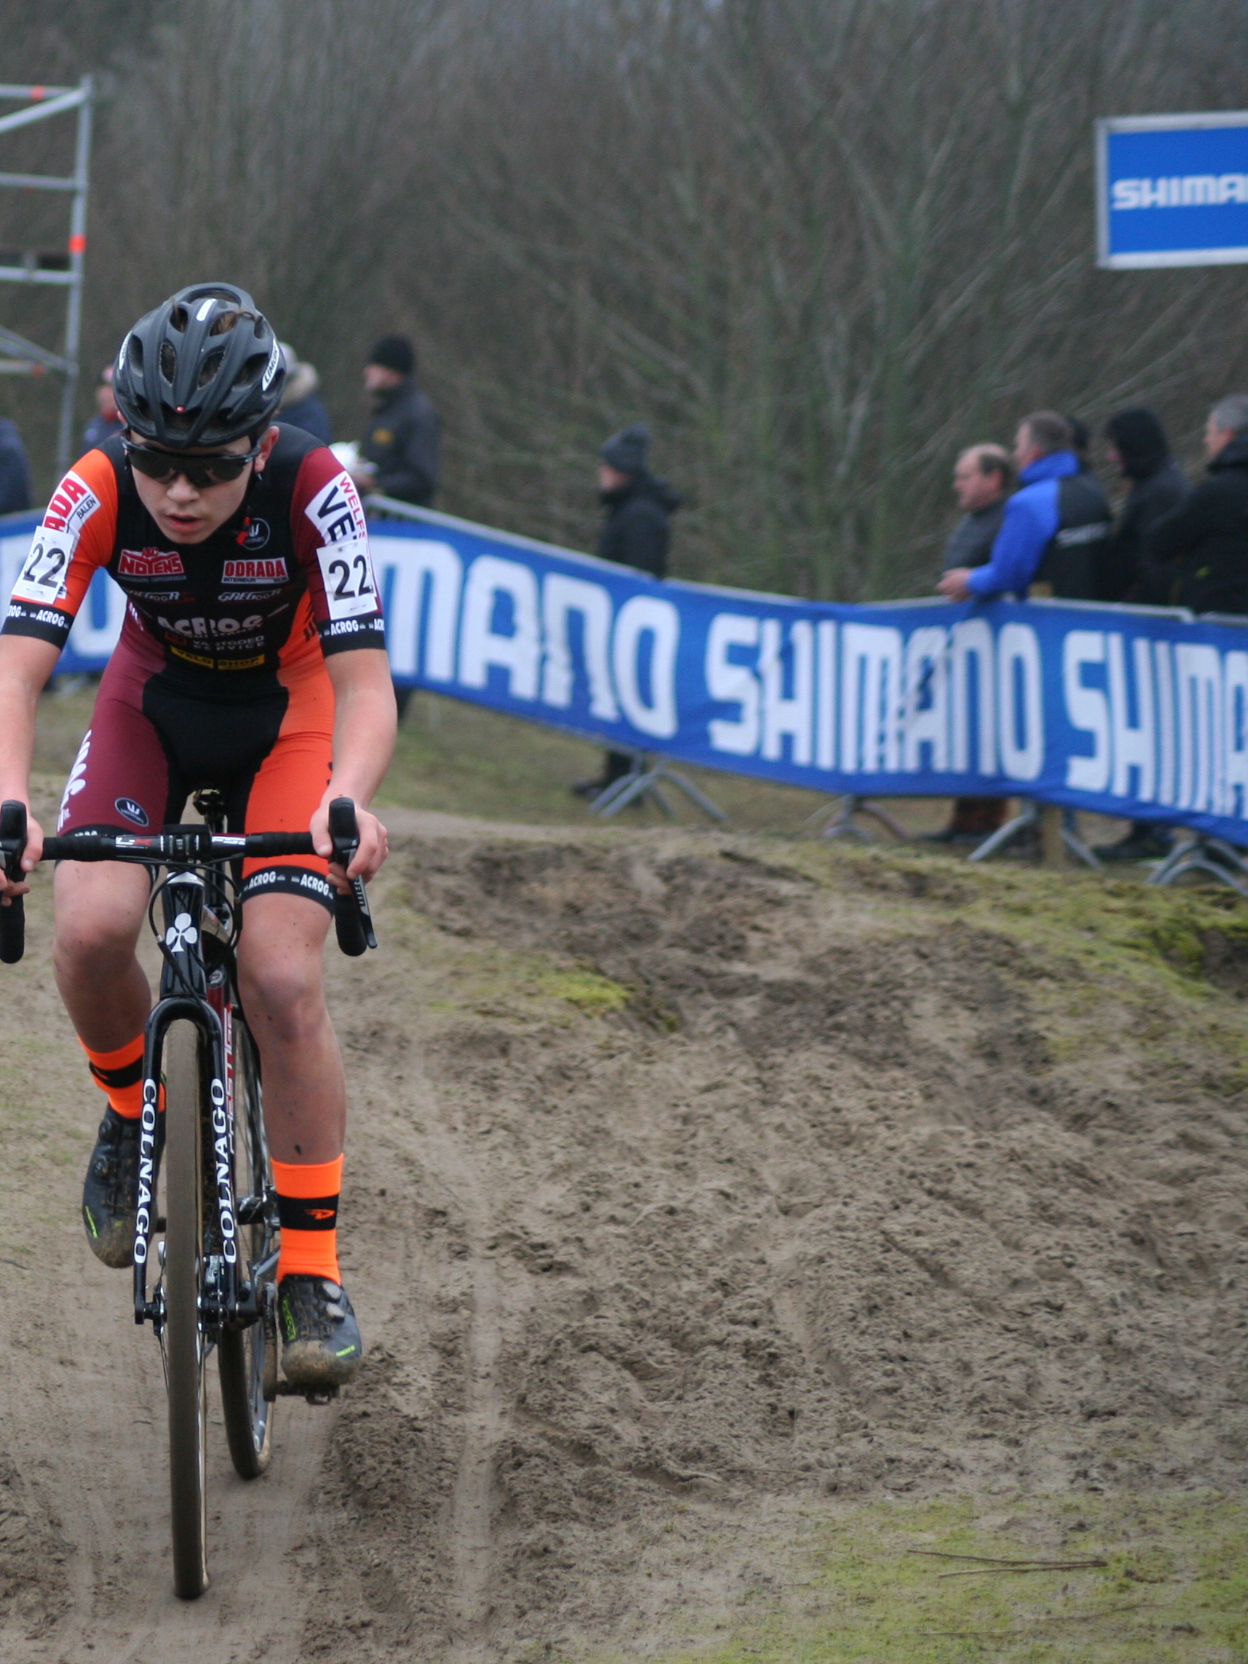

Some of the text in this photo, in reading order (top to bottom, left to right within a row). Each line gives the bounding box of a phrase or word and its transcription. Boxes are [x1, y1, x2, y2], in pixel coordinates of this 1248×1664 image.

[1111, 172, 1248, 210] SHIMA
[75, 498, 97, 520] BALEN
[317, 485, 358, 543] VE
[22, 542, 66, 588] 22
[328, 554, 372, 601] 22
[36, 609, 65, 627] ACROG
[330, 619, 359, 636] ACROG
[705, 612, 1045, 782] SHIMANO
[248, 871, 277, 890] ACROG
[300, 873, 329, 896] ACROG
[133, 1078, 157, 1264] COLNAGO
[210, 1078, 237, 1264] COLNAGO
